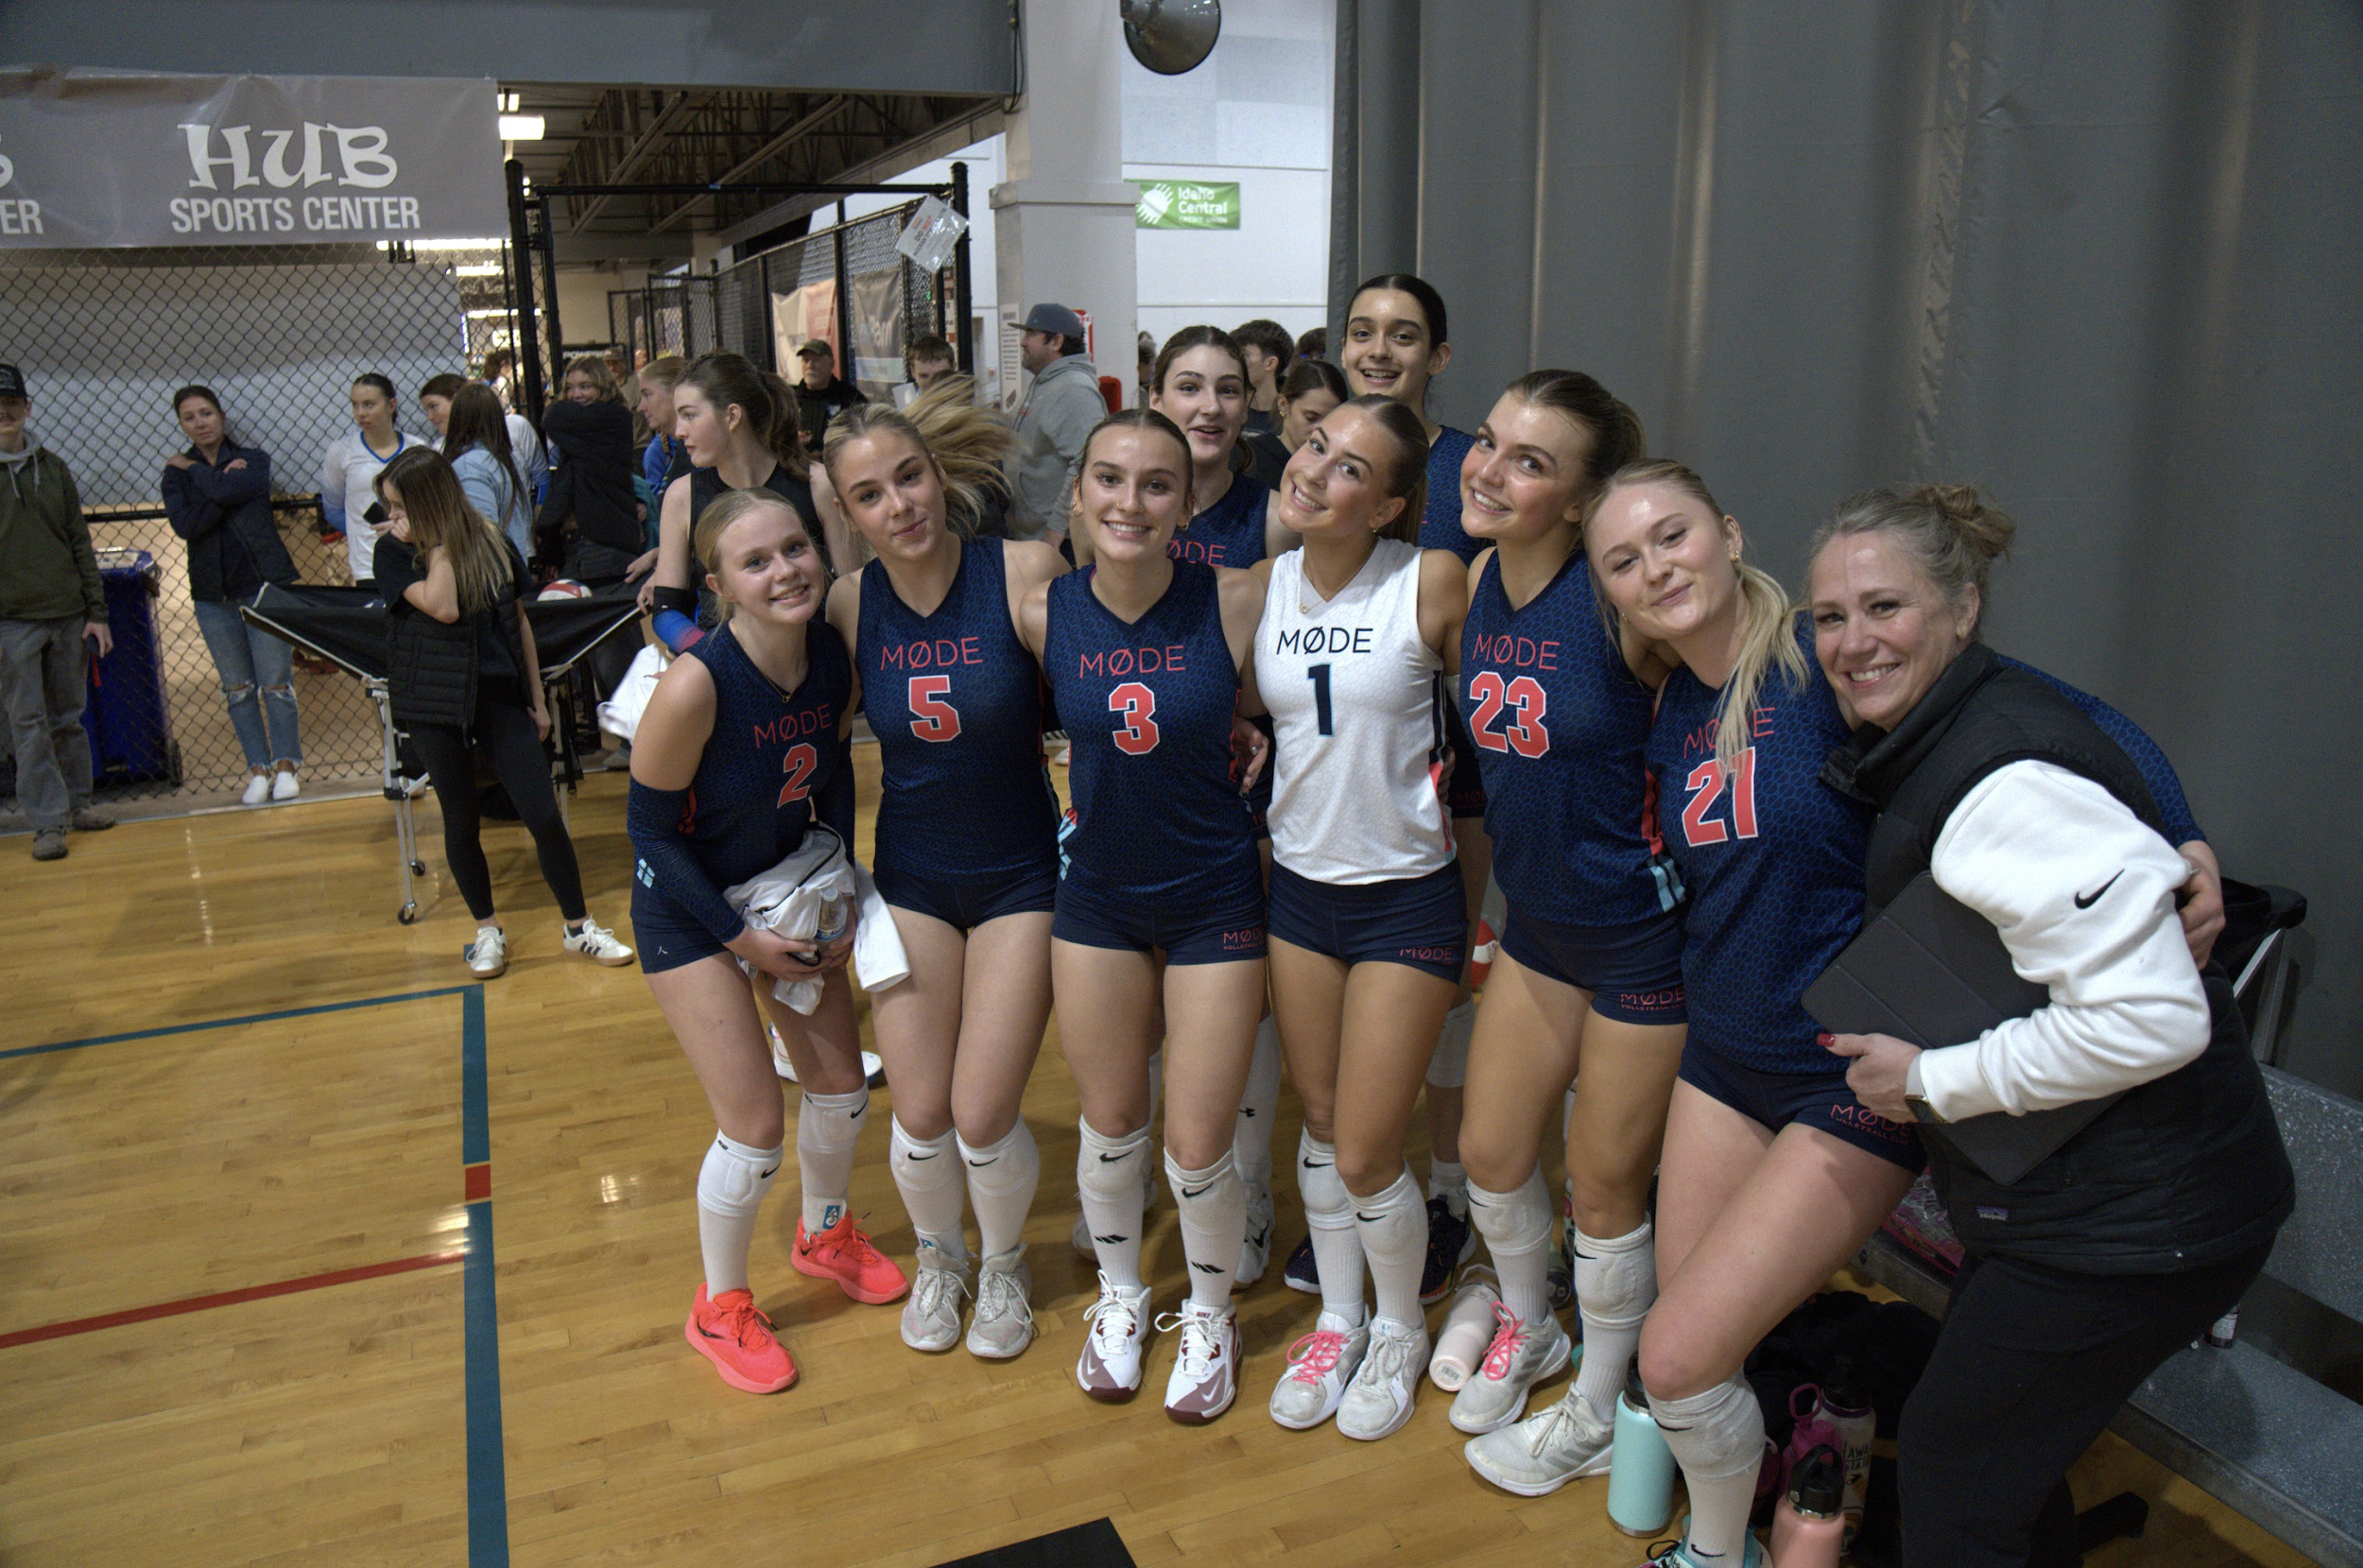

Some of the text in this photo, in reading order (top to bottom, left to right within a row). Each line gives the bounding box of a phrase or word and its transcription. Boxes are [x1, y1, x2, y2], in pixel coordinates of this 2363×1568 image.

[177, 121, 398, 191] HUB
[1177, 186, 1215, 200] Idaho
[1178, 200, 1228, 214] Central
[170, 196, 422, 233] SPORTS CENTER
[880, 636, 983, 671] MØDE
[1275, 627, 1374, 655] MØDE
[1472, 633, 1560, 670] MØDE
[1079, 646, 1186, 679] MØDE
[908, 674, 962, 743] 5
[1108, 681, 1160, 756] 3
[1306, 663, 1335, 737] 1
[1470, 670, 1550, 759] 23
[753, 703, 832, 749] MØDE
[776, 742, 818, 809] 2
[1682, 746, 1759, 848] 21
[1400, 947, 1453, 960] MØDE
